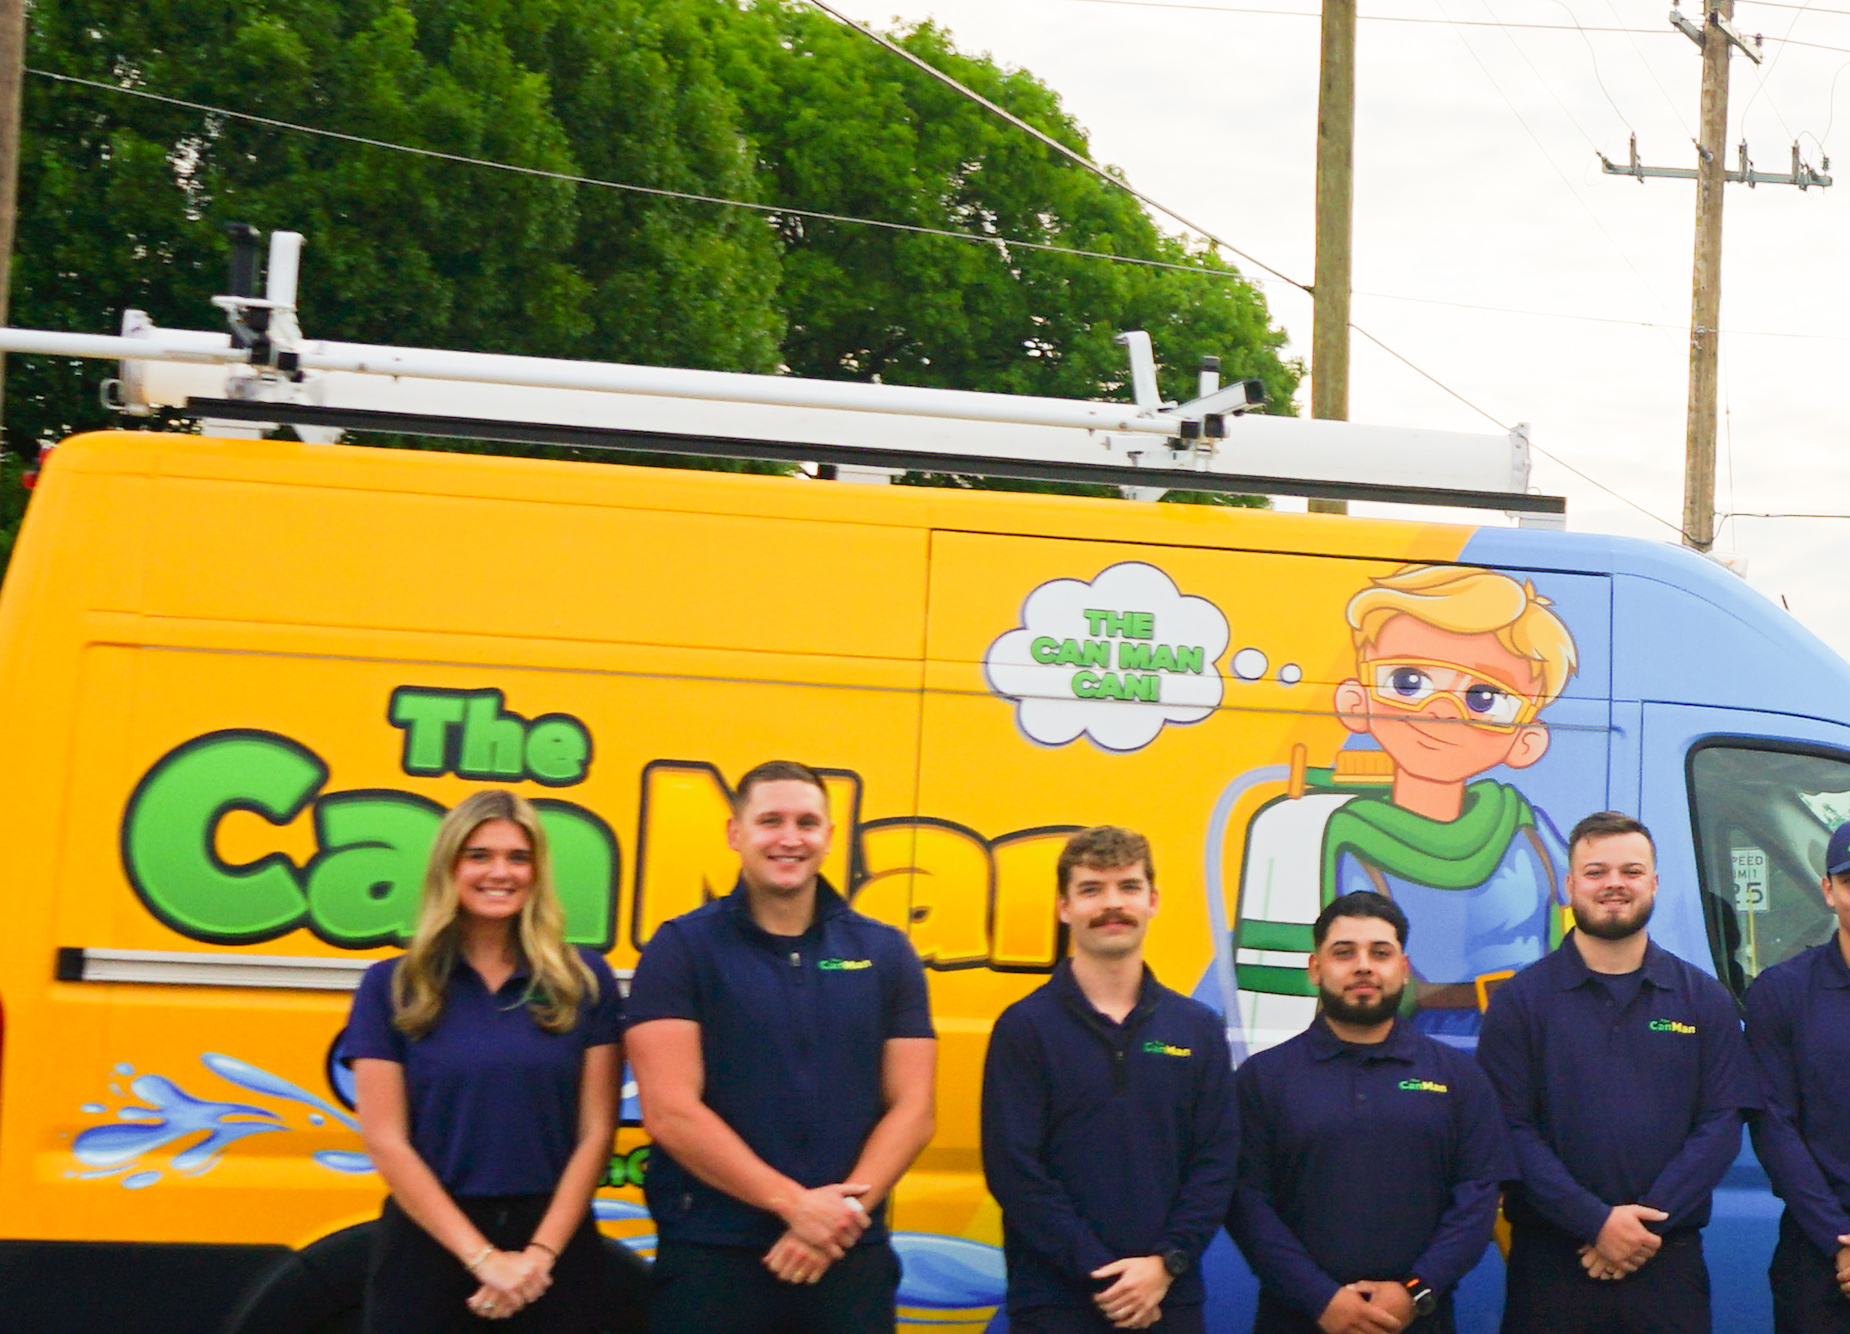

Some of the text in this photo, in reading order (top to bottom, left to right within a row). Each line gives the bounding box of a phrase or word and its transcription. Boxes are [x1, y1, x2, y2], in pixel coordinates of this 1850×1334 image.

[1083, 609, 1152, 640] THE
[1030, 636, 1201, 674] CAN MAN
[388, 685, 593, 787] The
[1732, 856, 1763, 866] PEED
